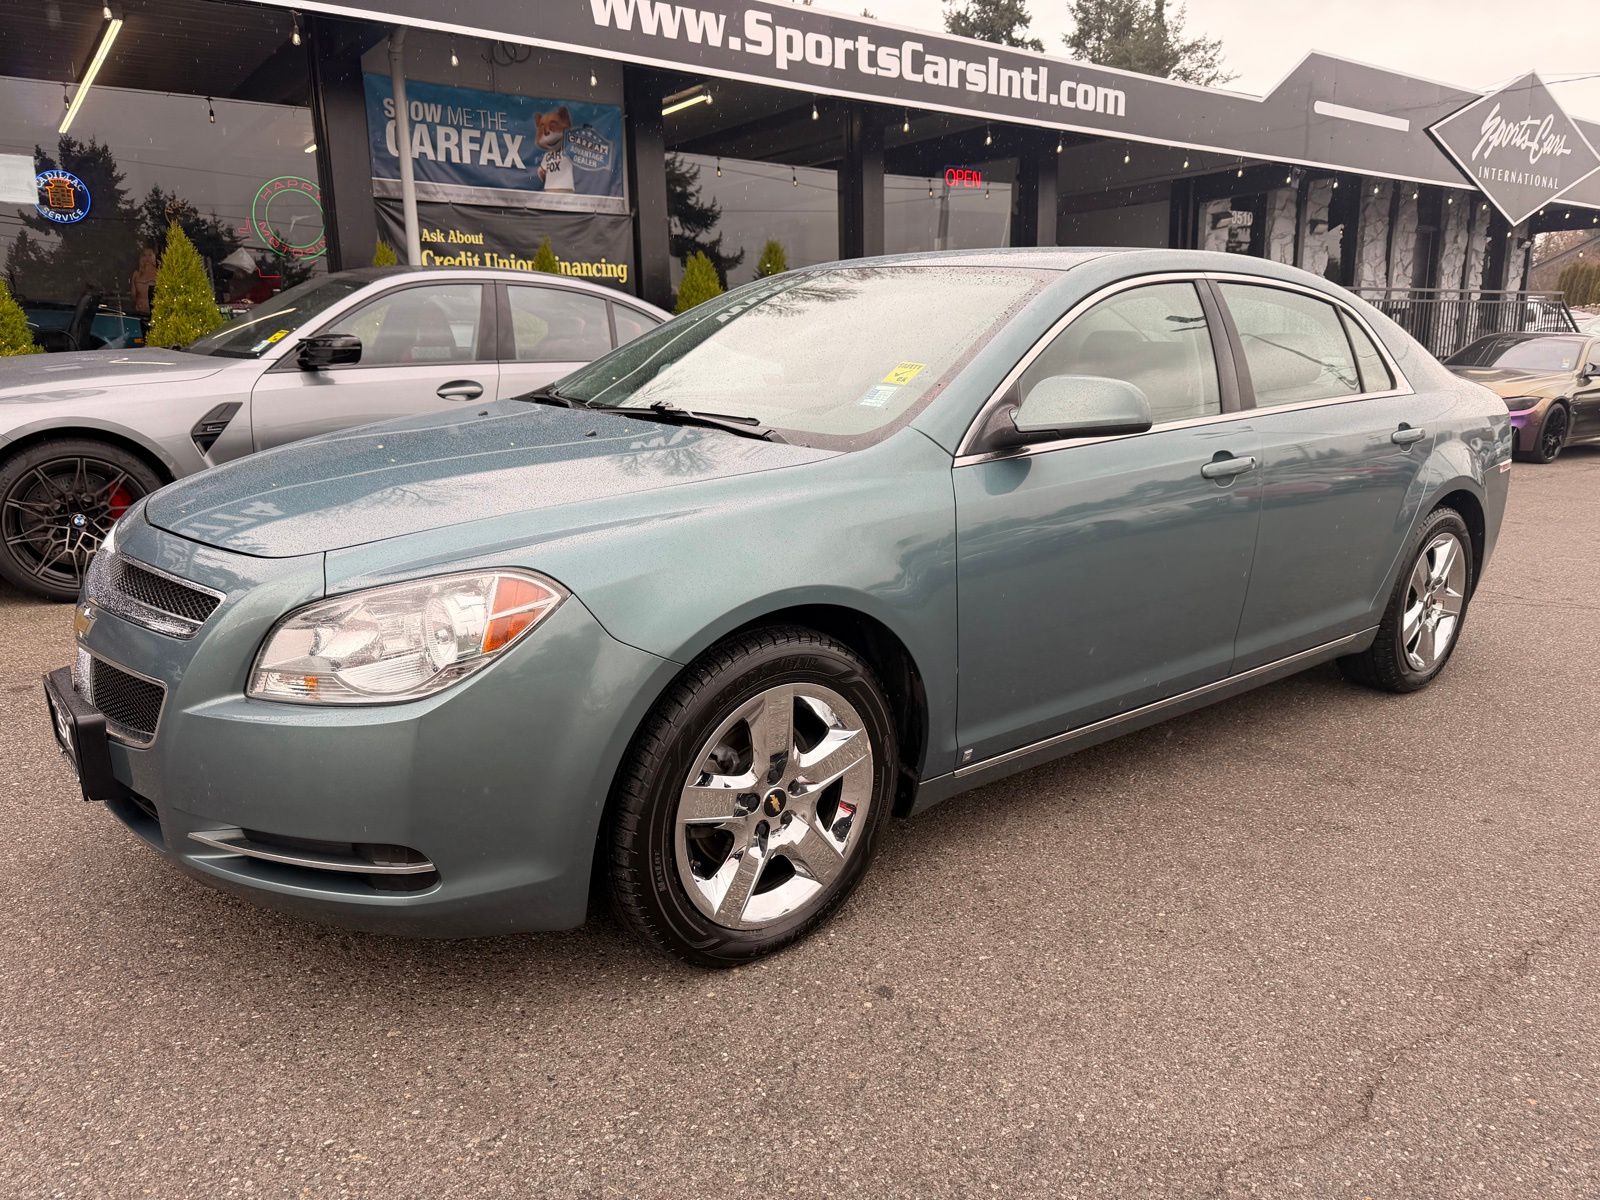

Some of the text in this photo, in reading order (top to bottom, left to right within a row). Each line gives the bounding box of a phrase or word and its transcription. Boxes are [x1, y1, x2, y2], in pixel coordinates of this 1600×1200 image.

[590, 0, 1126, 117] www.SportsCarsIntl.com
[382, 97, 507, 131] SOW ME THE
[573, 154, 597, 168] DEALER
[945, 168, 982, 189] OPEN
[1478, 166, 1559, 190] INTERNATIONAL
[43, 207, 84, 222] SERVICE
[421, 228, 484, 245] Ask About
[556, 256, 628, 284] inancing
